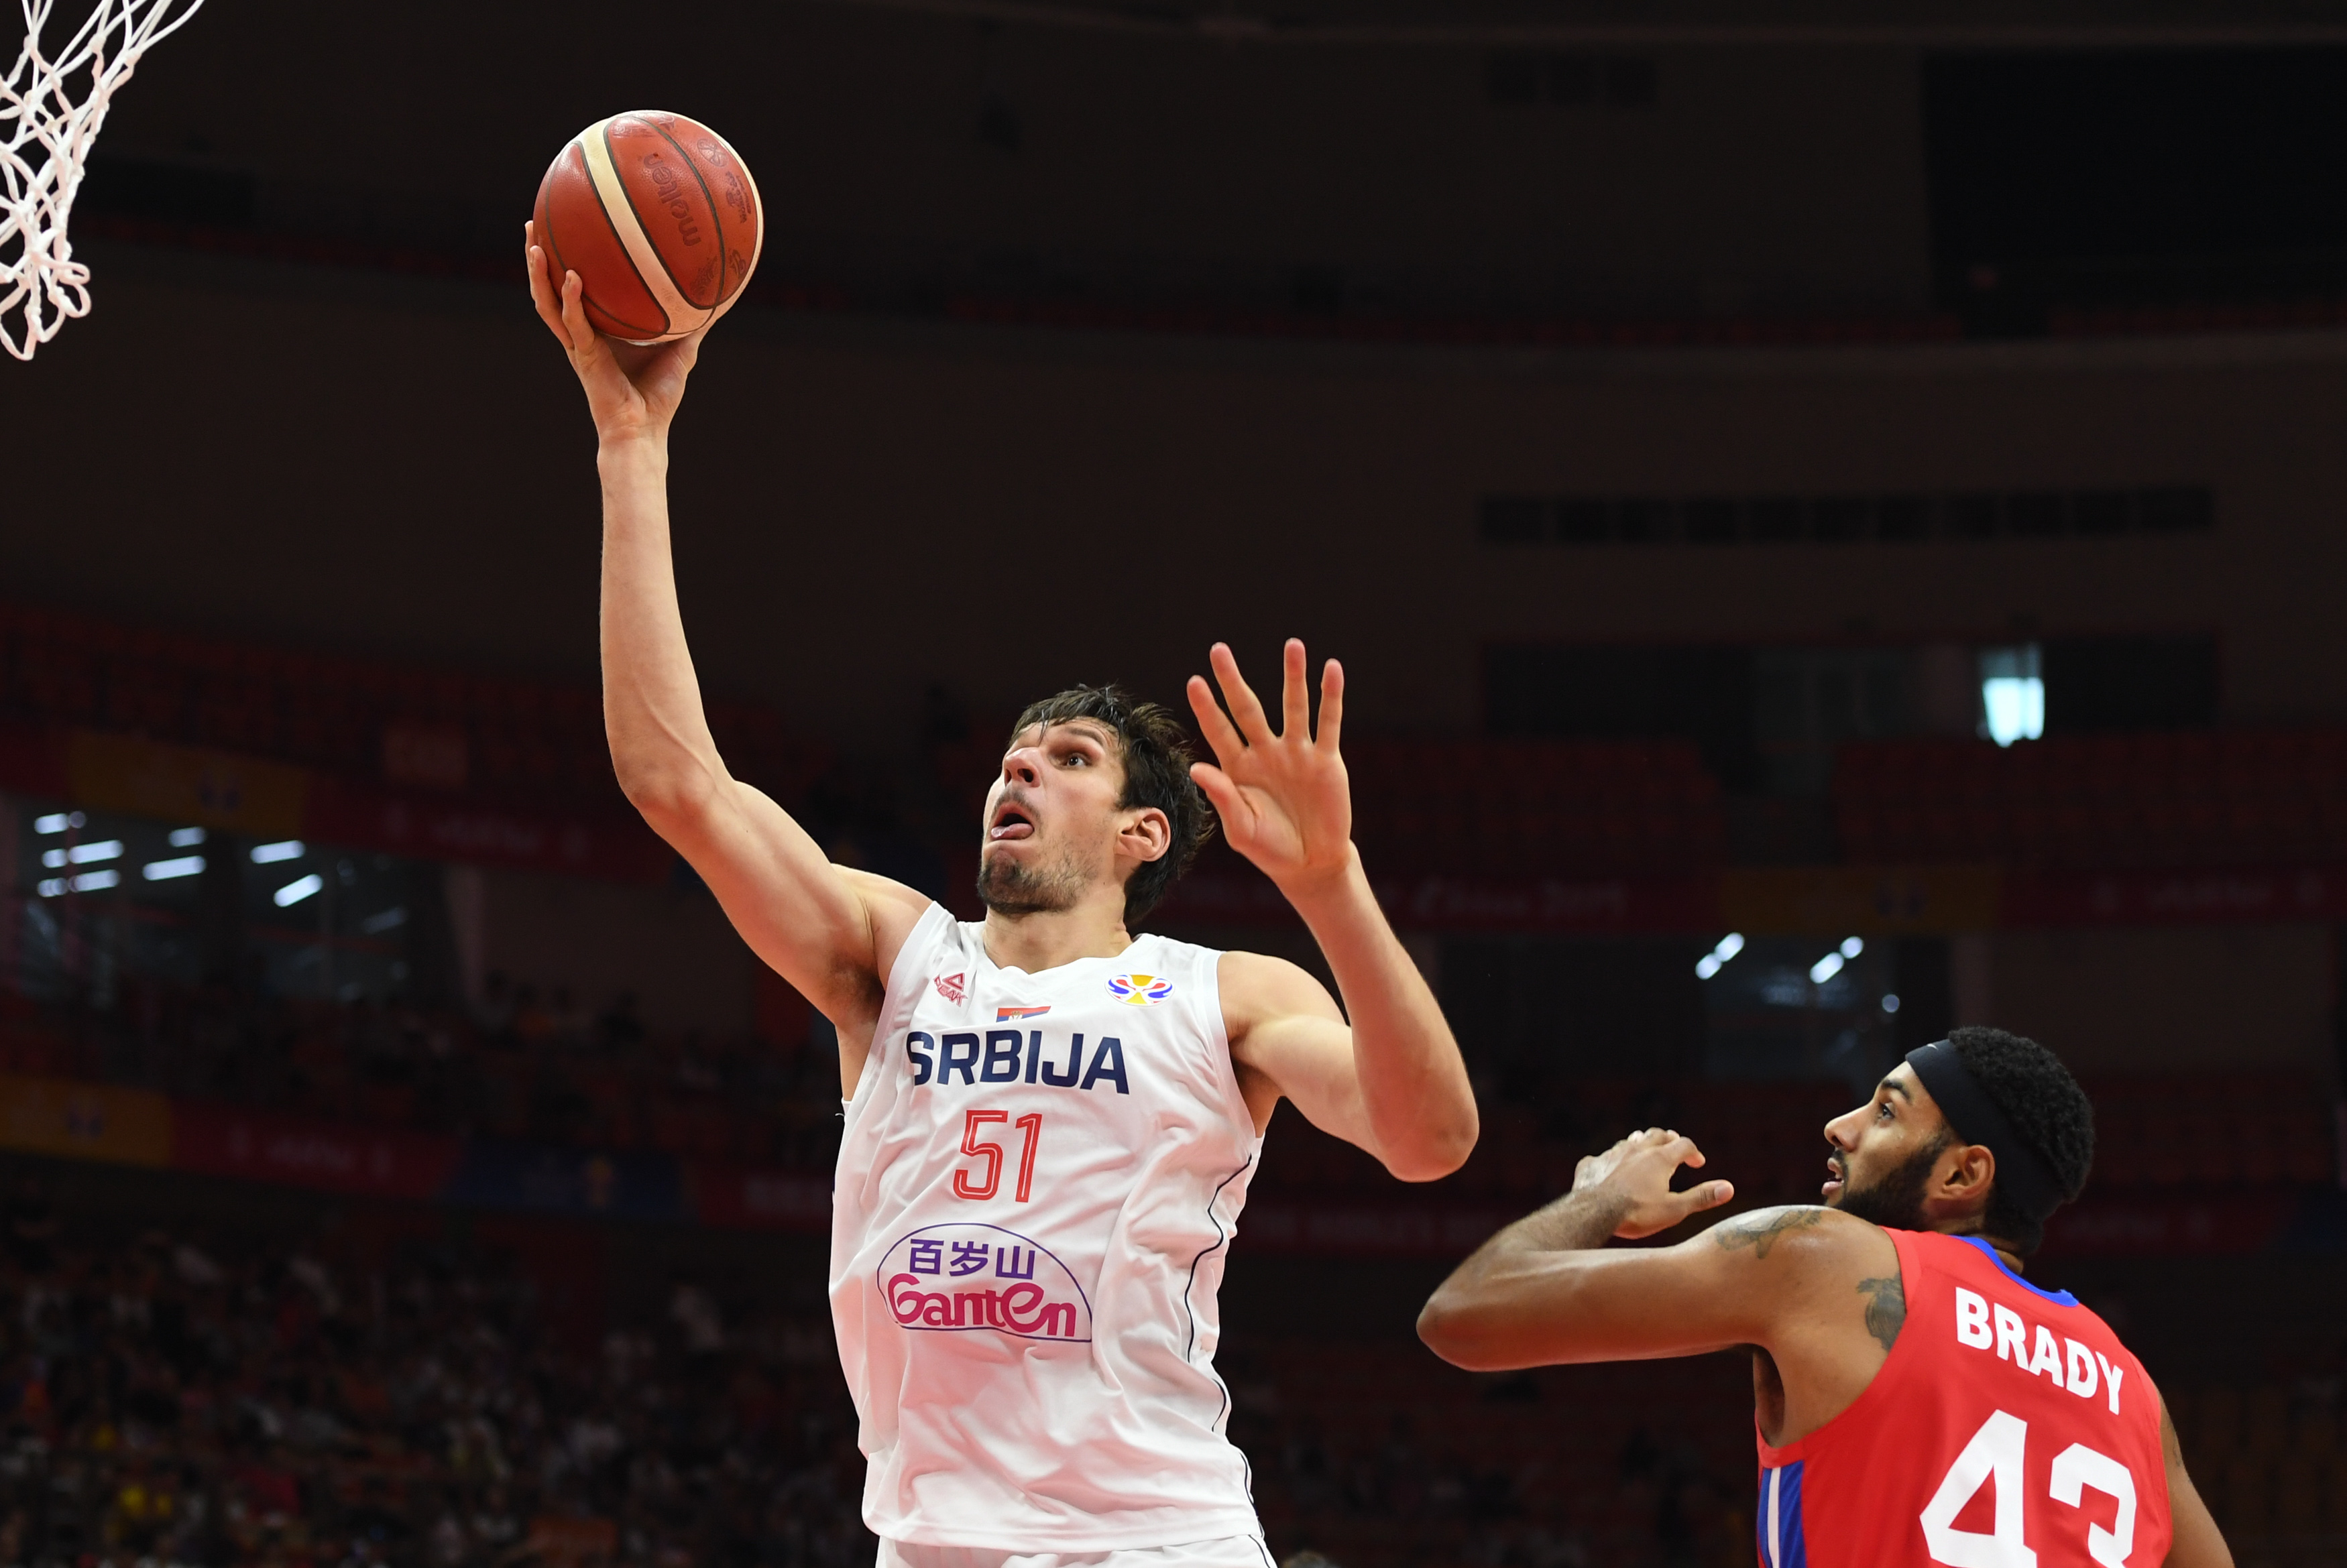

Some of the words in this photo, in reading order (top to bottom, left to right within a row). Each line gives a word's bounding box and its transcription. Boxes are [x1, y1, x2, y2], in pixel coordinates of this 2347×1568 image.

[644, 153, 701, 247] molten
[933, 973, 968, 1007] PEAK
[906, 1030, 1130, 1095] SRBIJA
[953, 1109, 1043, 1203] 51
[909, 1239, 1035, 1280] 百岁山
[1955, 1286, 2124, 1415] BRADY
[1920, 1409, 2137, 1568] 43
